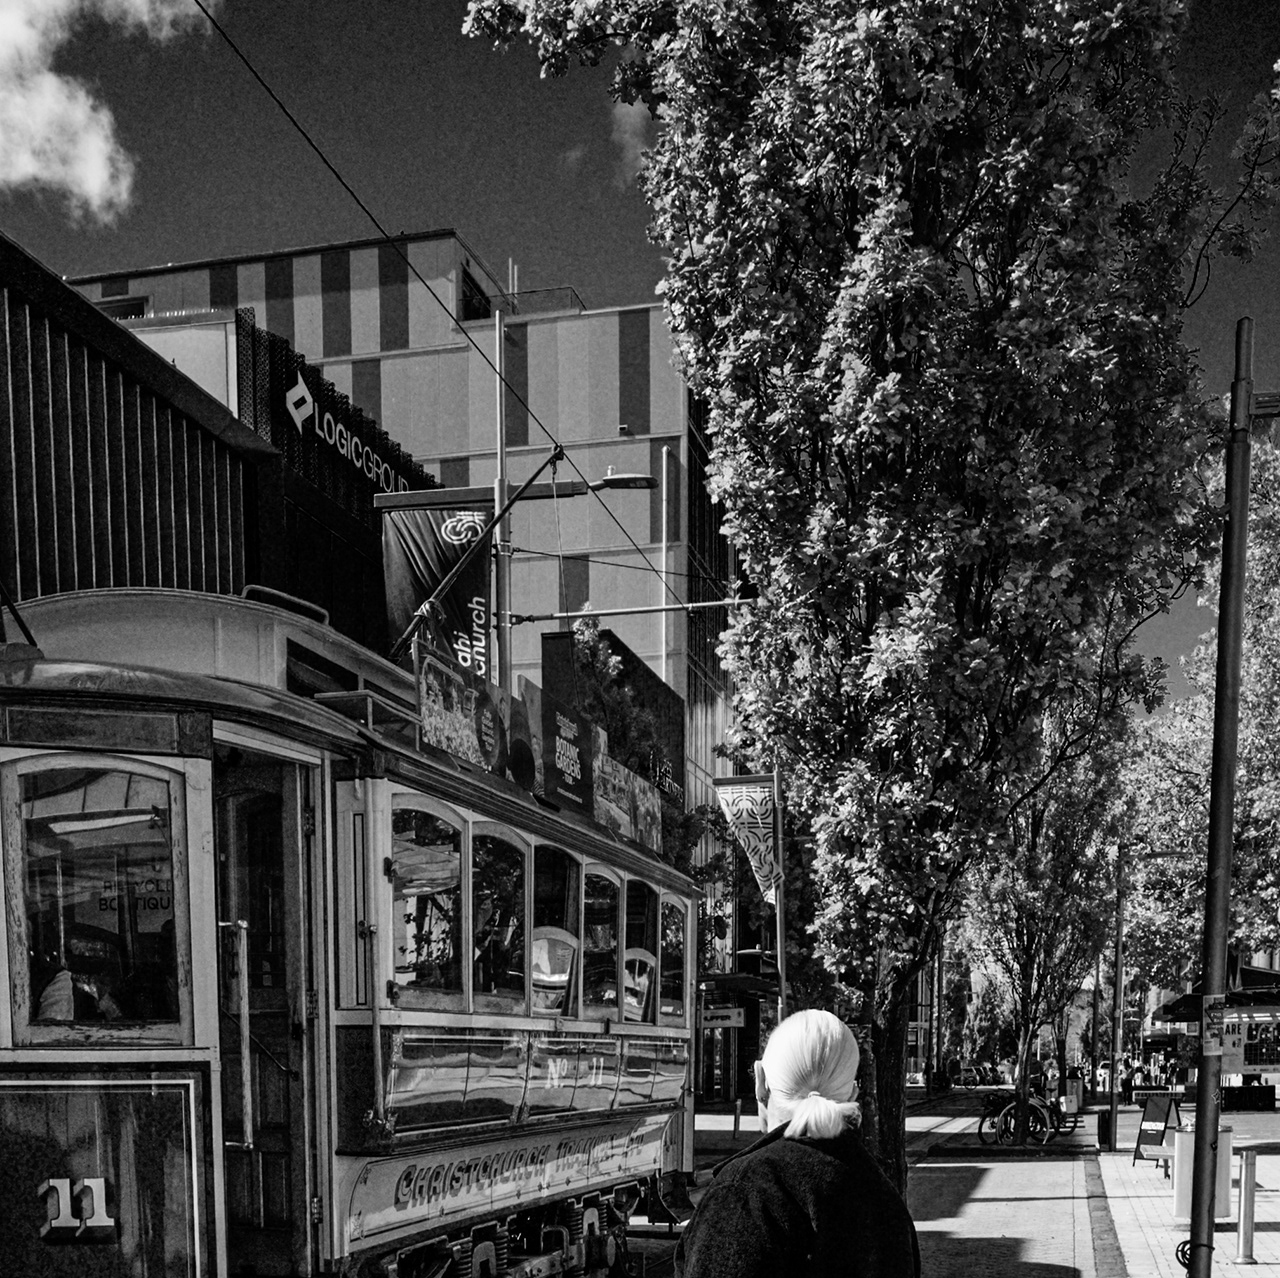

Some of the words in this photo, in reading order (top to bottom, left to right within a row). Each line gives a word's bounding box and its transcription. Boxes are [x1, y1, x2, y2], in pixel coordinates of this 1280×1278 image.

[453, 630, 472, 667] ahi
[467, 596, 486, 678] church
[39, 1177, 115, 1233] 11
[393, 1144, 551, 1212] CHRISTCHURCH
